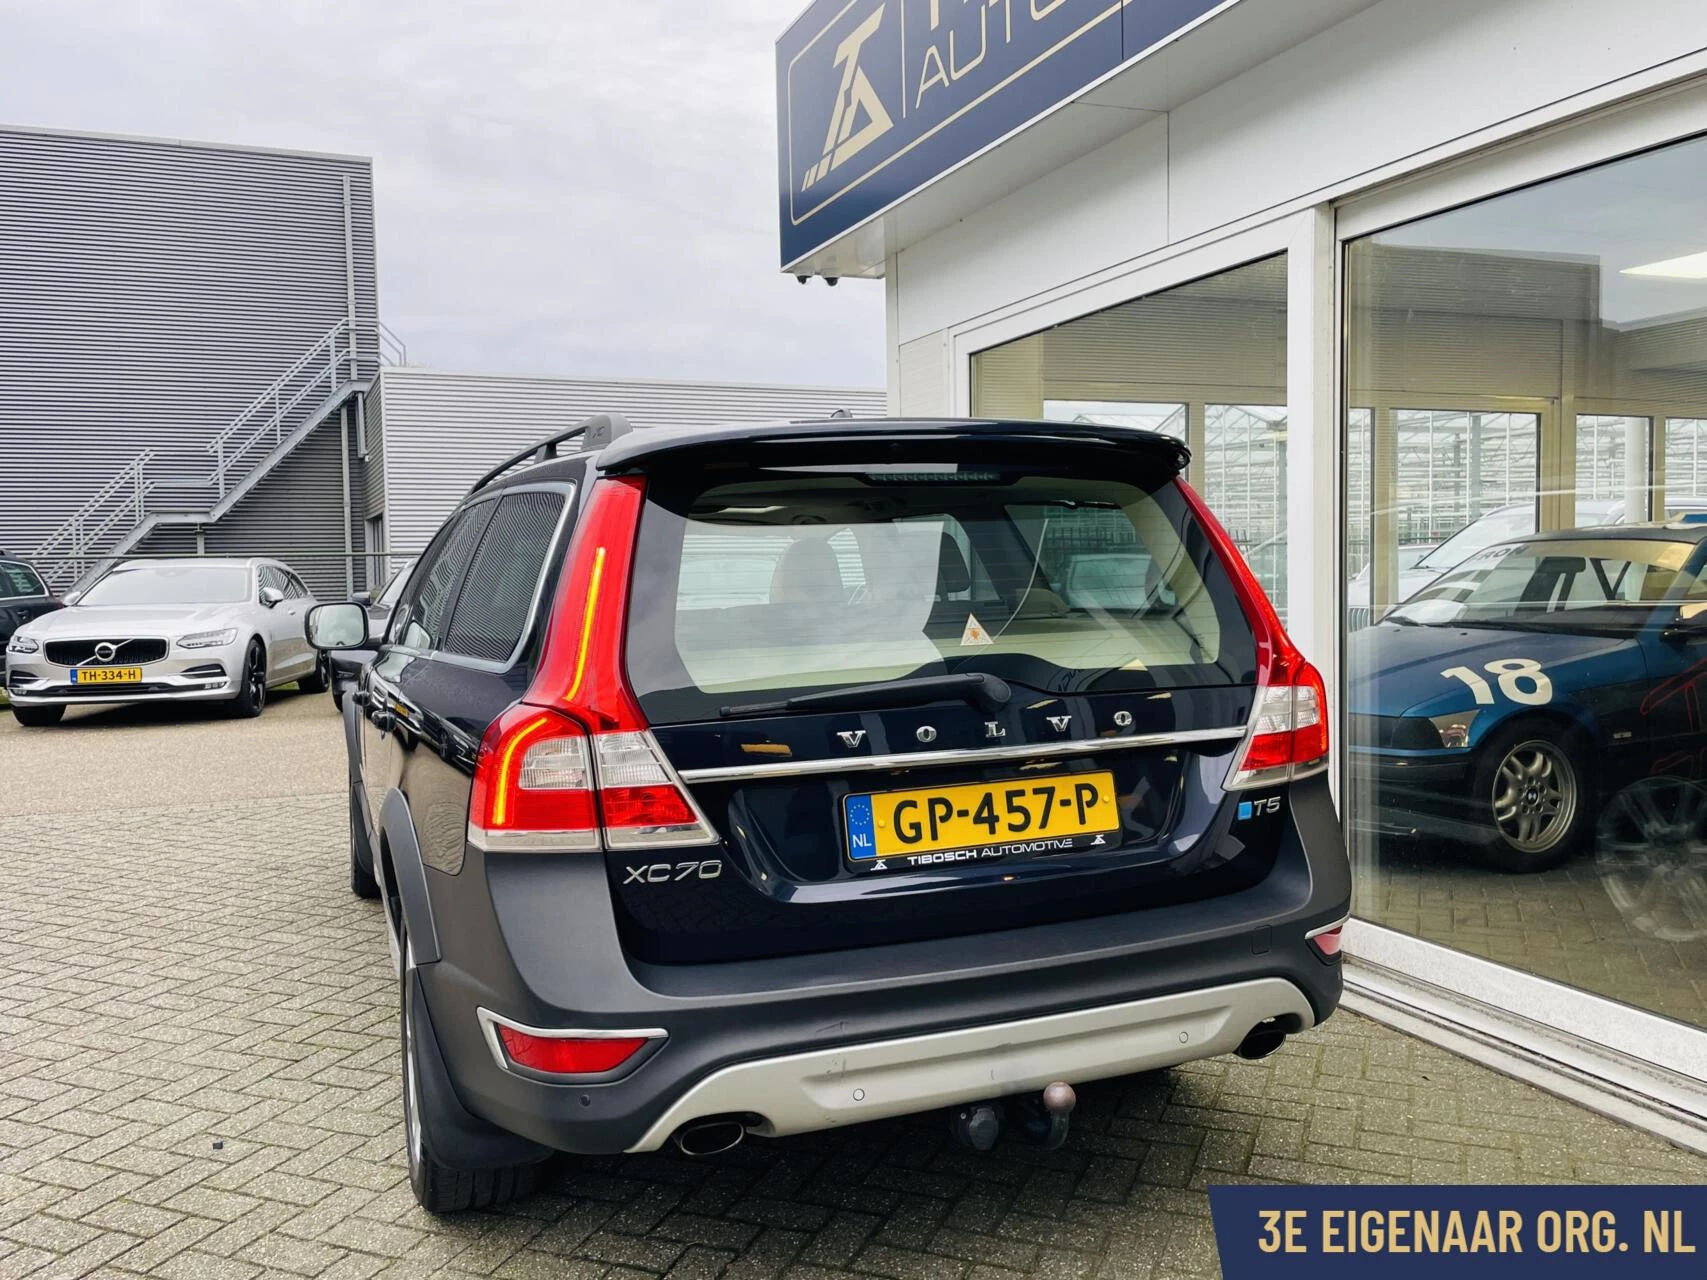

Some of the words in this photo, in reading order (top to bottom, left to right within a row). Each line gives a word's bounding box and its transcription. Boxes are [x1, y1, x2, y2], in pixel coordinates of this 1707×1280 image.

[81, 669, 136, 681] TH-334-H
[1440, 658, 1553, 705] 18
[837, 710, 1134, 749] VOLVO
[892, 782, 1099, 844] GP-457-P
[1253, 796, 1282, 817] T5
[852, 834, 873, 848] NL
[906, 849, 977, 866] TIBOSCH
[981, 838, 1073, 858] AUTOMOTIVE
[623, 859, 722, 885] XC70
